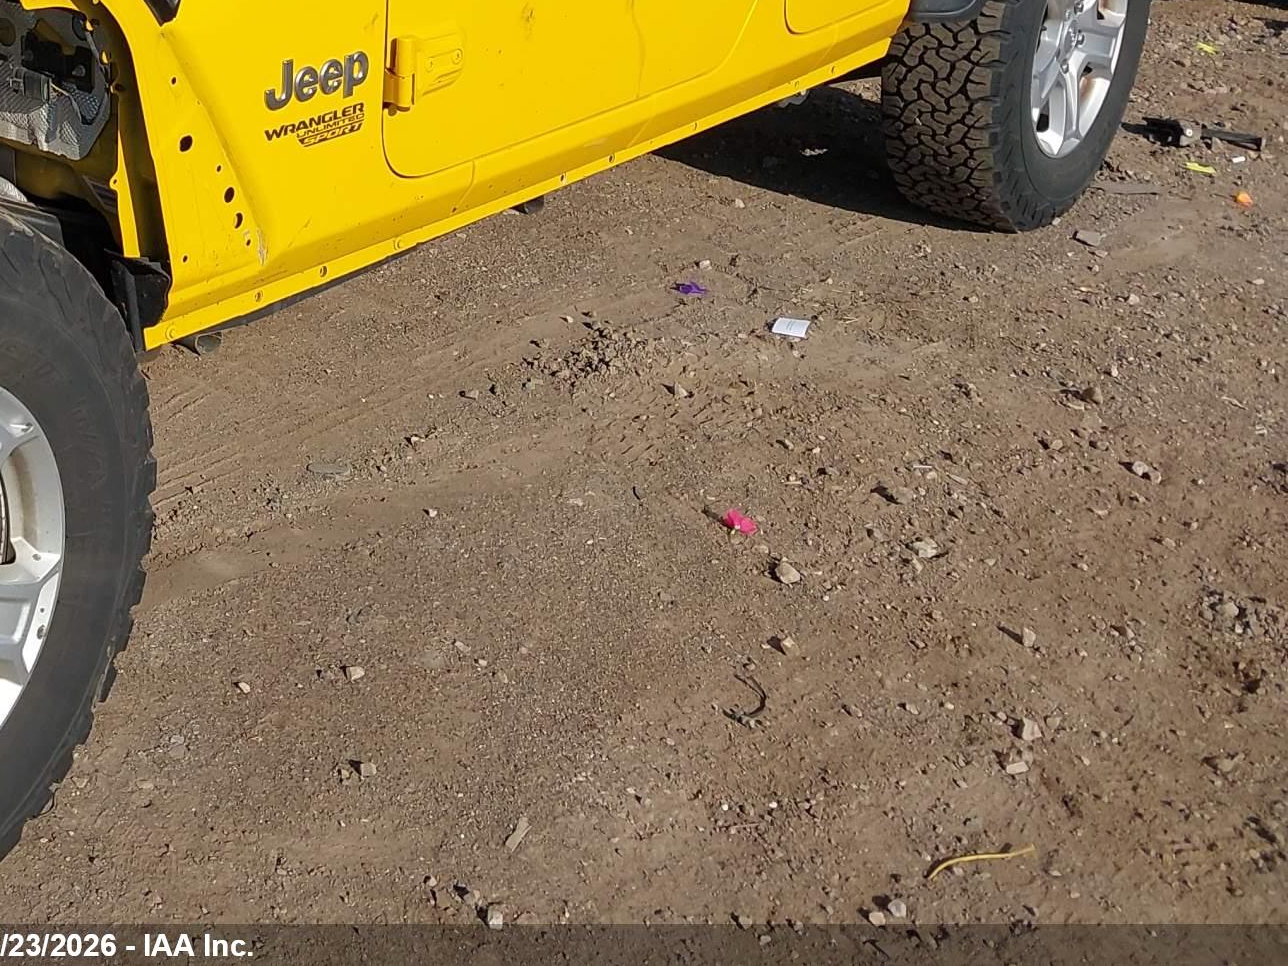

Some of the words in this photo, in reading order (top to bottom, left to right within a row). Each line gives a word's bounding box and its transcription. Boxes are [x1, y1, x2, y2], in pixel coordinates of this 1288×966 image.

[264, 51, 369, 111] Jeep
[264, 102, 365, 141] WRANGLER
[296, 113, 365, 138] UNLIMITED
[302, 122, 363, 145] SPORT
